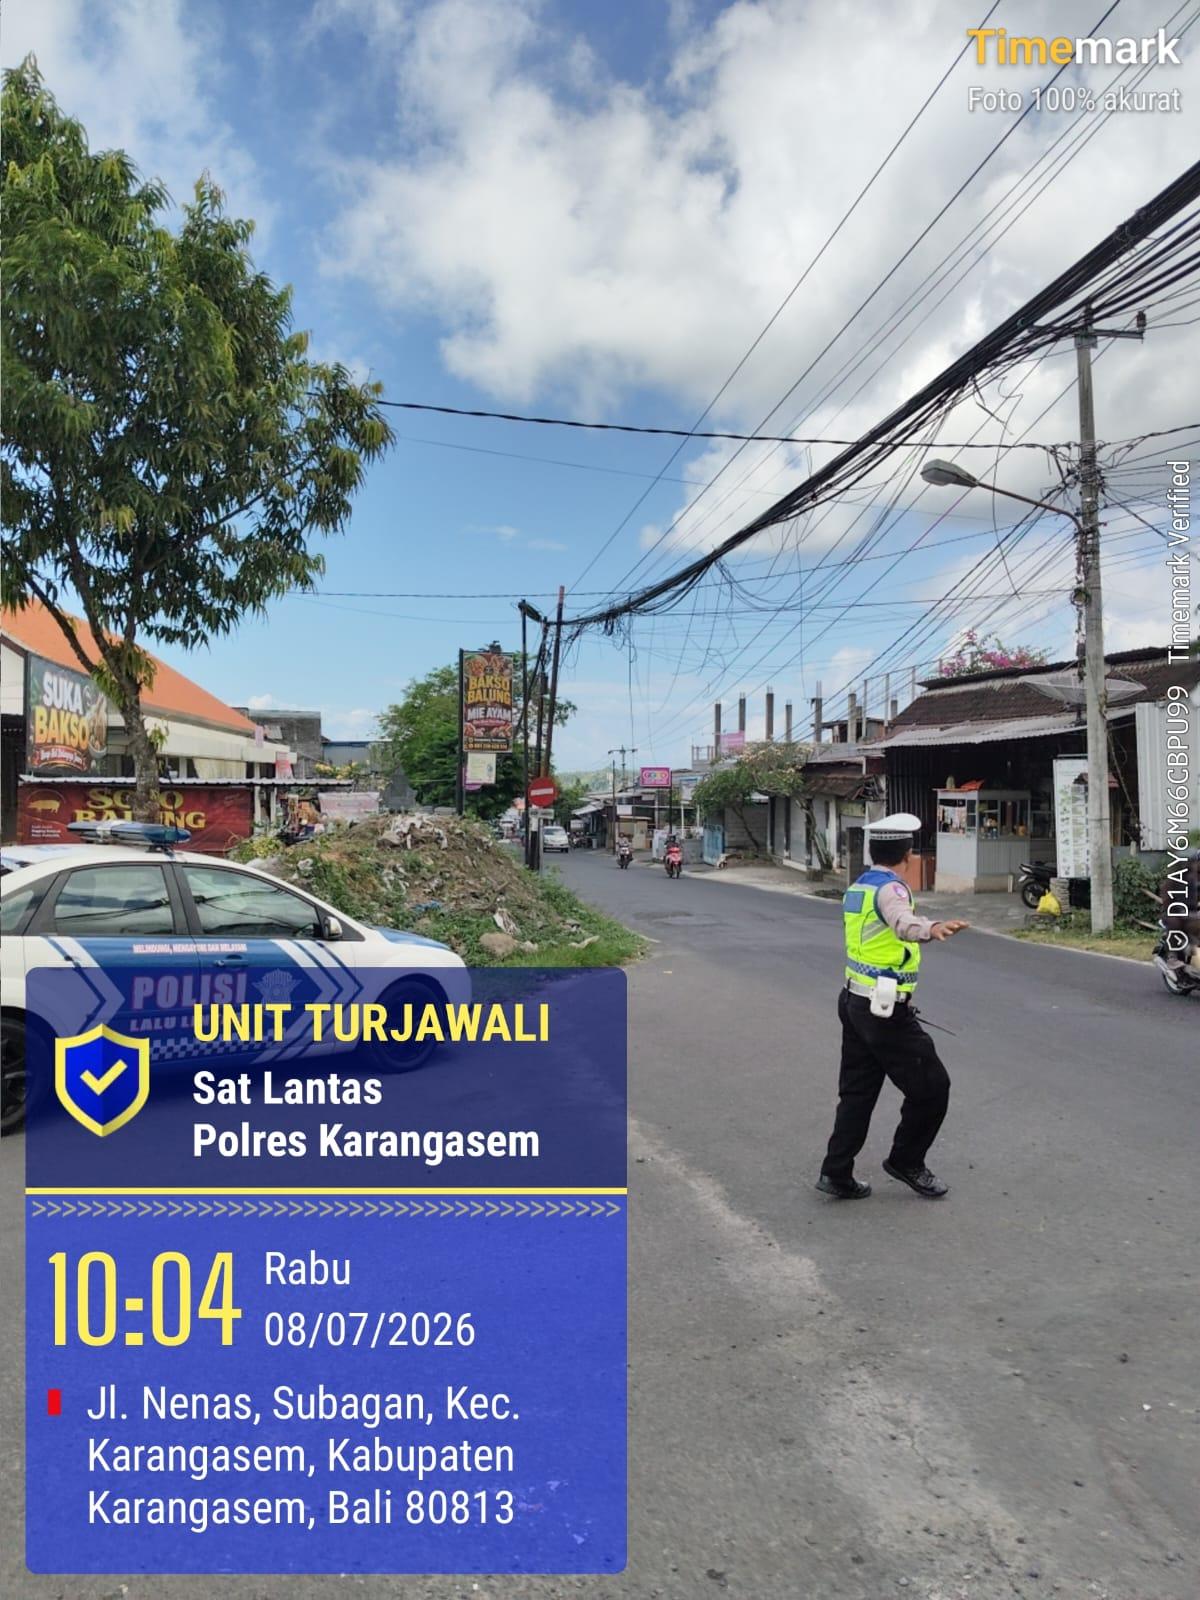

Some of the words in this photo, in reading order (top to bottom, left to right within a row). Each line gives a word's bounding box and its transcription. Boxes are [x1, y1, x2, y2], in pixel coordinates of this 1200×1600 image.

[43, 671, 83, 715] SUKA
[469, 674, 510, 692] BAKSO
[467, 687, 511, 707] BALUNG
[467, 706, 485, 721] MIE
[486, 707, 512, 722] AYAM
[35, 705, 89, 750] BAKSO
[87, 788, 184, 810] SOO
[132, 973, 247, 1010] POLISI
[130, 1016, 178, 1032] LALU
